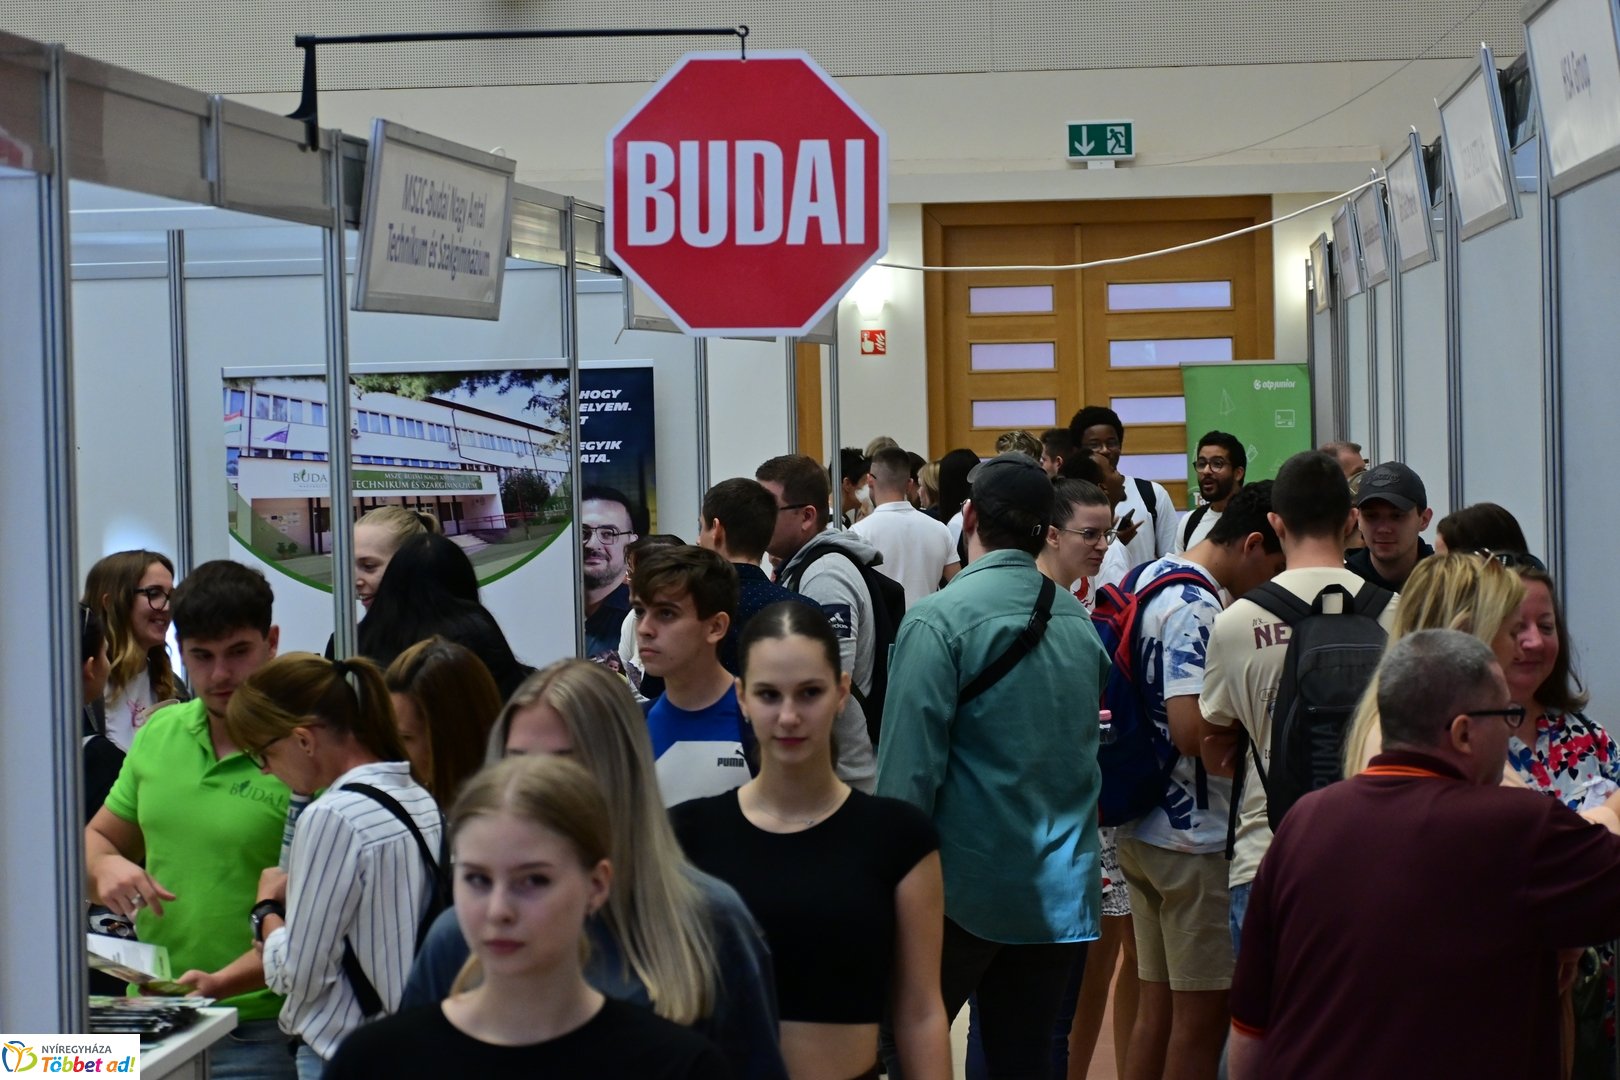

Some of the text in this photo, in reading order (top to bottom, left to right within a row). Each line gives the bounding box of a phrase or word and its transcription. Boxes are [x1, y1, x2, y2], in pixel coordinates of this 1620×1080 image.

[402, 173, 487, 233] MSZC-Budai Nagy Antal
[627, 139, 865, 248] BUDAI
[387, 223, 427, 267] Technikum
[428, 229, 438, 269] és
[579, 389, 622, 400] HOGY
[717, 757, 744, 768] PUMA
